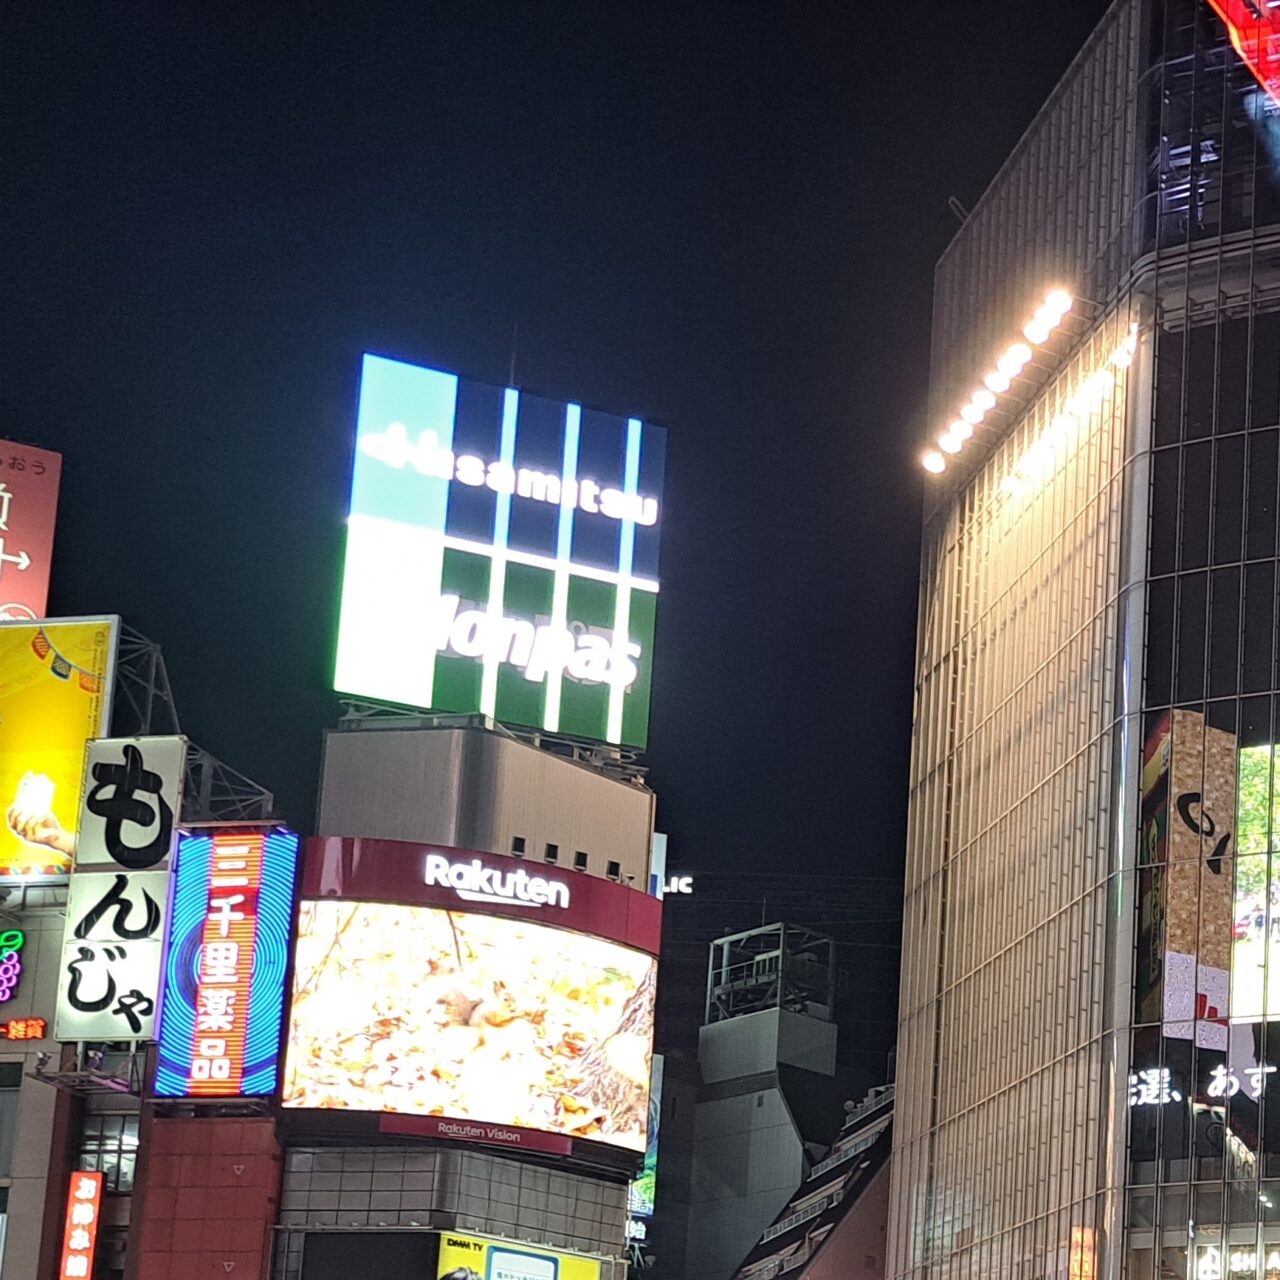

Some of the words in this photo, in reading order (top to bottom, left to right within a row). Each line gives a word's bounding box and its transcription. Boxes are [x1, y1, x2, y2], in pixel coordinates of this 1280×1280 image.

[0, 456, 46, 475] おう
[67, 745, 173, 1034] もんじゃ
[424, 854, 570, 909] Rakuten
[191, 845, 250, 1080] 三千里薬品
[438, 1121, 485, 1139] Rakuten
[486, 1126, 521, 1142] Vision
[447, 1238, 470, 1250] DMM
[473, 1240, 484, 1252] TV
